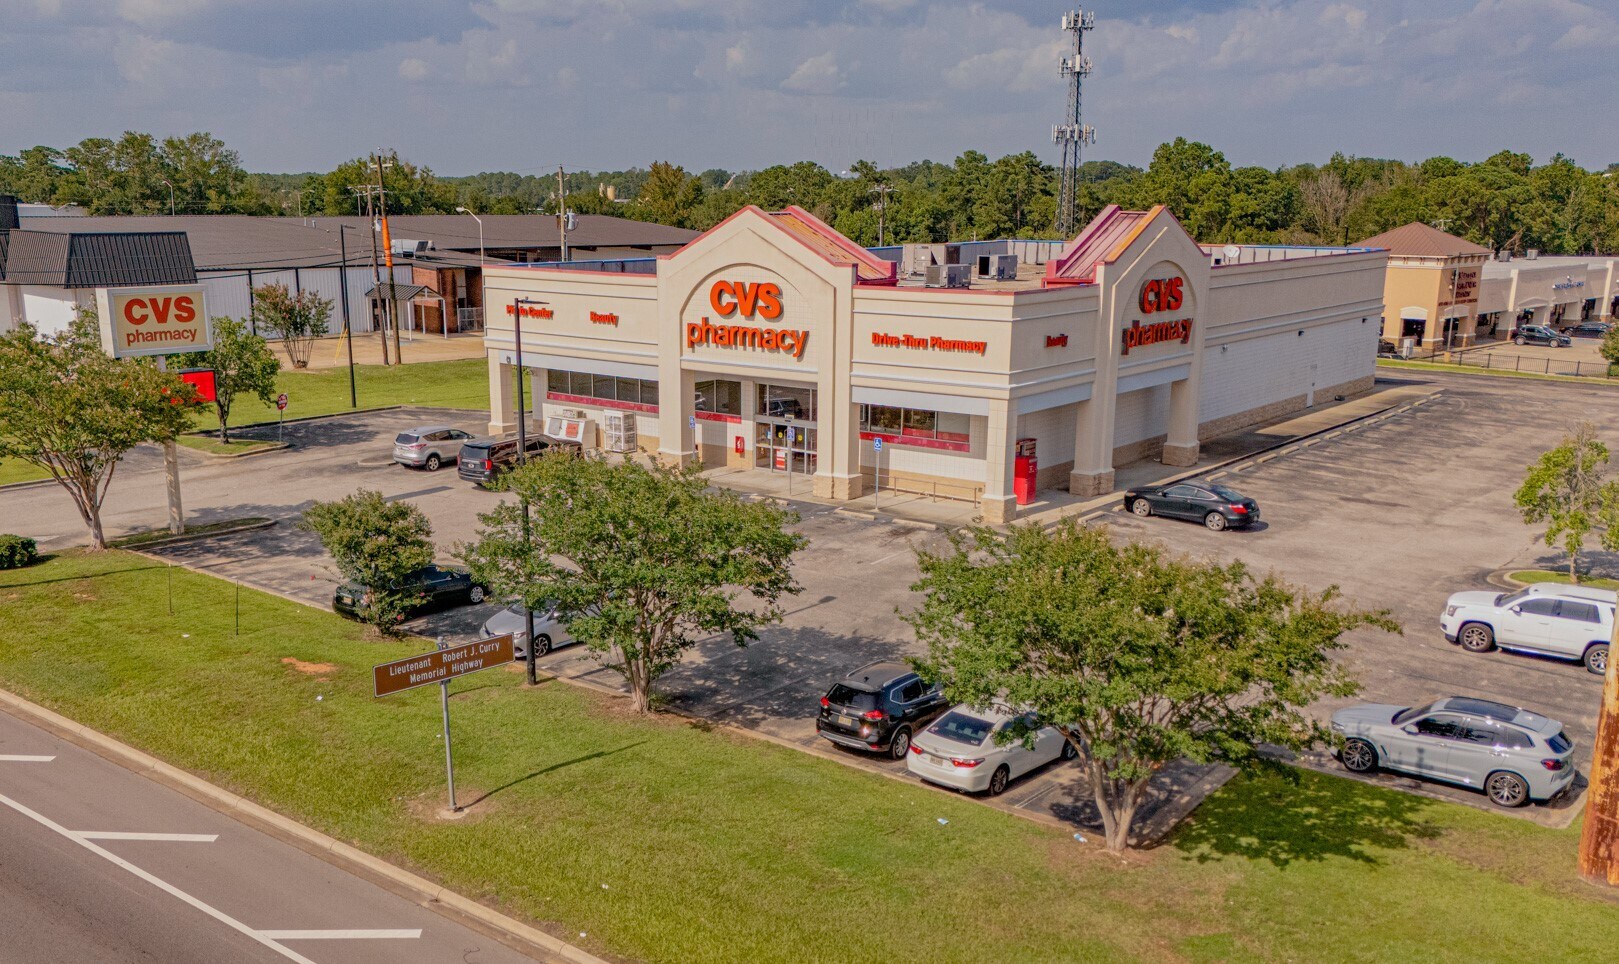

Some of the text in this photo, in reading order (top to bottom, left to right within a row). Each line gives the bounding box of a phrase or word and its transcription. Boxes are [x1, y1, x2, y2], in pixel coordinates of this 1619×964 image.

[709, 280, 781, 319] CVS
[1139, 277, 1183, 314] CVS
[124, 296, 196, 325] CVS
[528, 307, 553, 320] Center
[590, 311, 618, 326] Beauty
[126, 329, 197, 347] pharmacy
[687, 317, 807, 358] pharmacy
[930, 336, 986, 355] Pharmacy
[1121, 318, 1193, 355] pharmacy
[389, 642, 500, 676] Lieutenant Robert J. Curry
[410, 659, 483, 684] Memorial Highway
